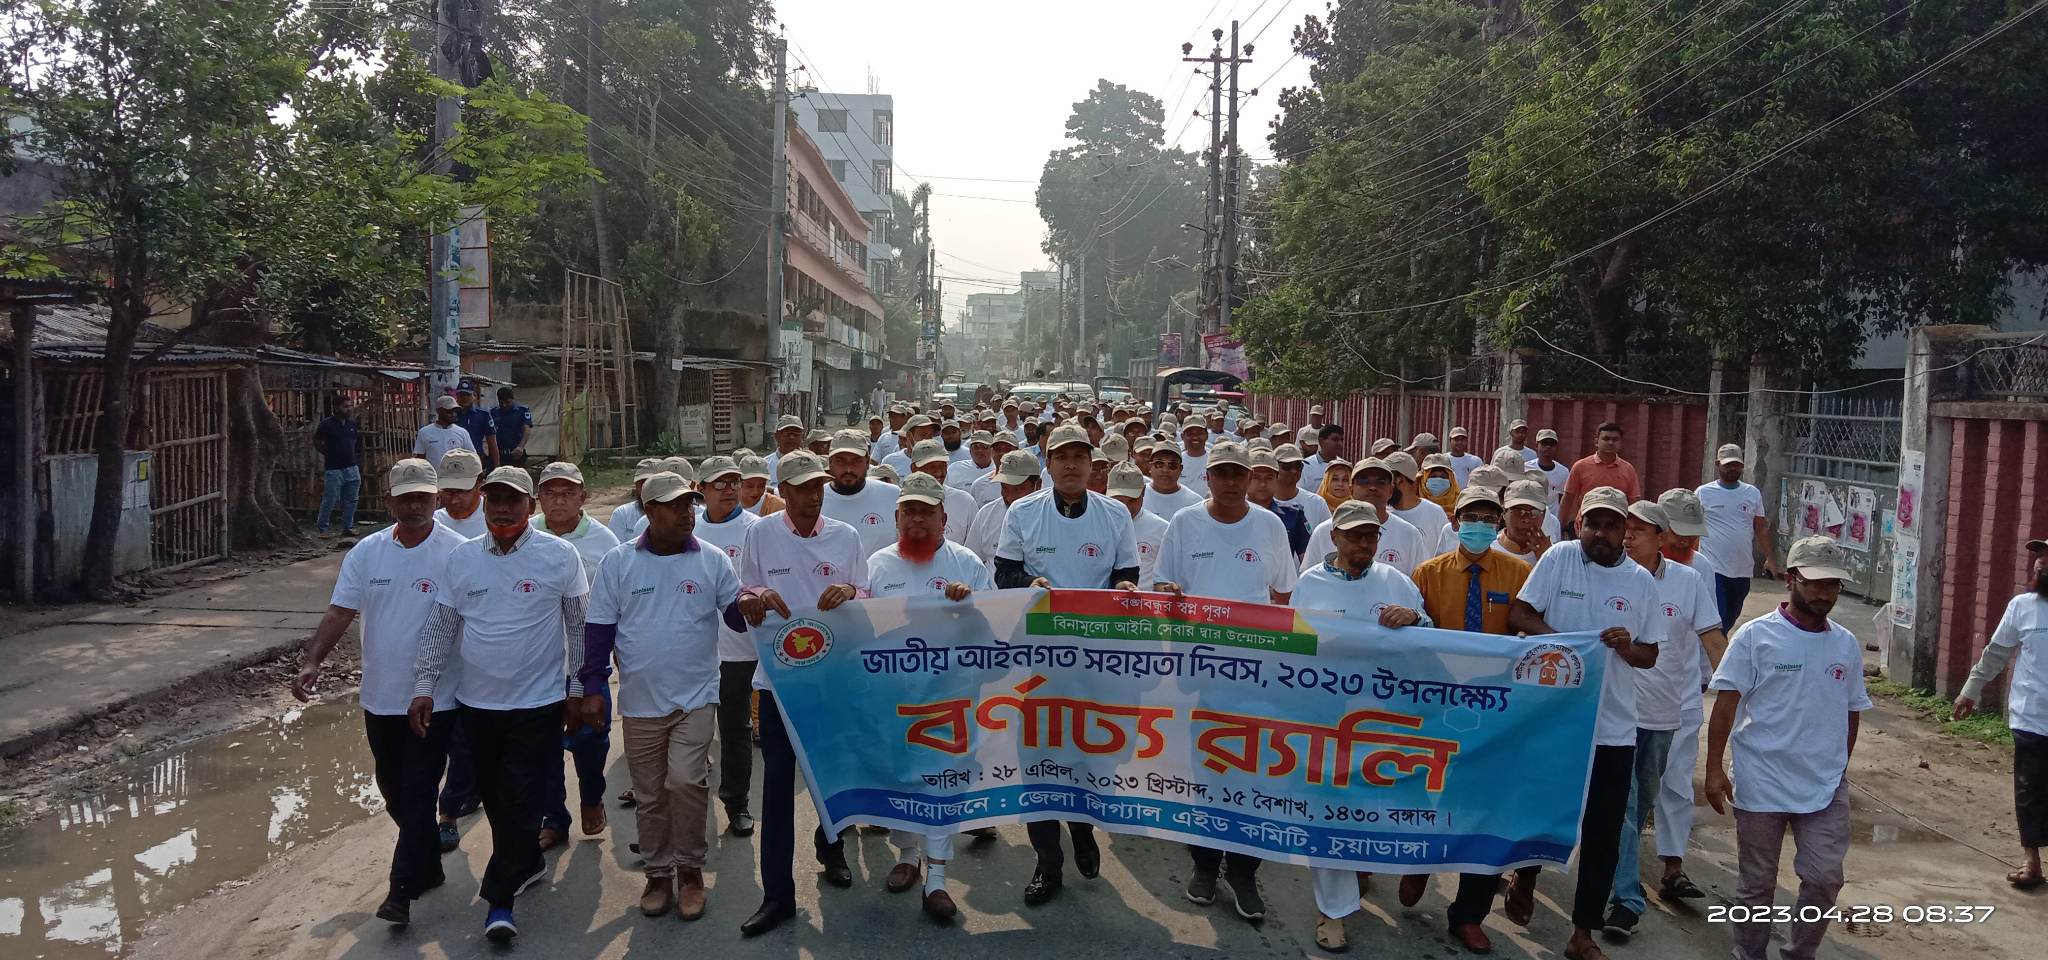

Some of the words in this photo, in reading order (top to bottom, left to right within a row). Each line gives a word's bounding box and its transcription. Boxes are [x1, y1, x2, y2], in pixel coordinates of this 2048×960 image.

[1053, 615, 1109, 636] বিনামূল্যে
[1114, 619, 1153, 635] আইনি
[1157, 622, 1195, 637] সেবার
[1199, 627, 1222, 640] দ্বার
[1226, 629, 1276, 645] উন্মোচন
[1177, 601, 1198, 615] স্বপ্ন
[1202, 603, 1231, 621] পূরণ
[860, 637, 950, 675] জাতীয়
[955, 639, 1079, 670] আইনগত
[1083, 648, 1184, 679] সহায়তা
[1189, 645, 1268, 688] দিবস,
[1277, 662, 1364, 696] ২০২৩
[1371, 666, 1512, 712] উপলক্ষ্যে
[897, 674, 1174, 758] বর্ণাঢ্য
[888, 794, 990, 821] আয়োজনে
[1018, 790, 1077, 808] জেলা
[1083, 793, 1163, 823] লিগ্যাল
[1172, 807, 1230, 833] এইড
[1237, 820, 1317, 854] কমিটি,
[1328, 836, 1430, 859] চুয়াডাঙ্গা
[921, 768, 971, 790] তারিখ
[992, 764, 1017, 782] ২৮
[1025, 759, 1080, 785] এপ্রিল,
[1086, 771, 1139, 790] ২০২৩
[1145, 772, 1214, 803] খ্রিস্টাব্দ,
[1222, 786, 1247, 806] ১৫
[1252, 788, 1314, 822] বৈশাখ,
[1323, 804, 1380, 823] ১৪৩০
[1387, 807, 1438, 827] বঙ্গাব্দ
